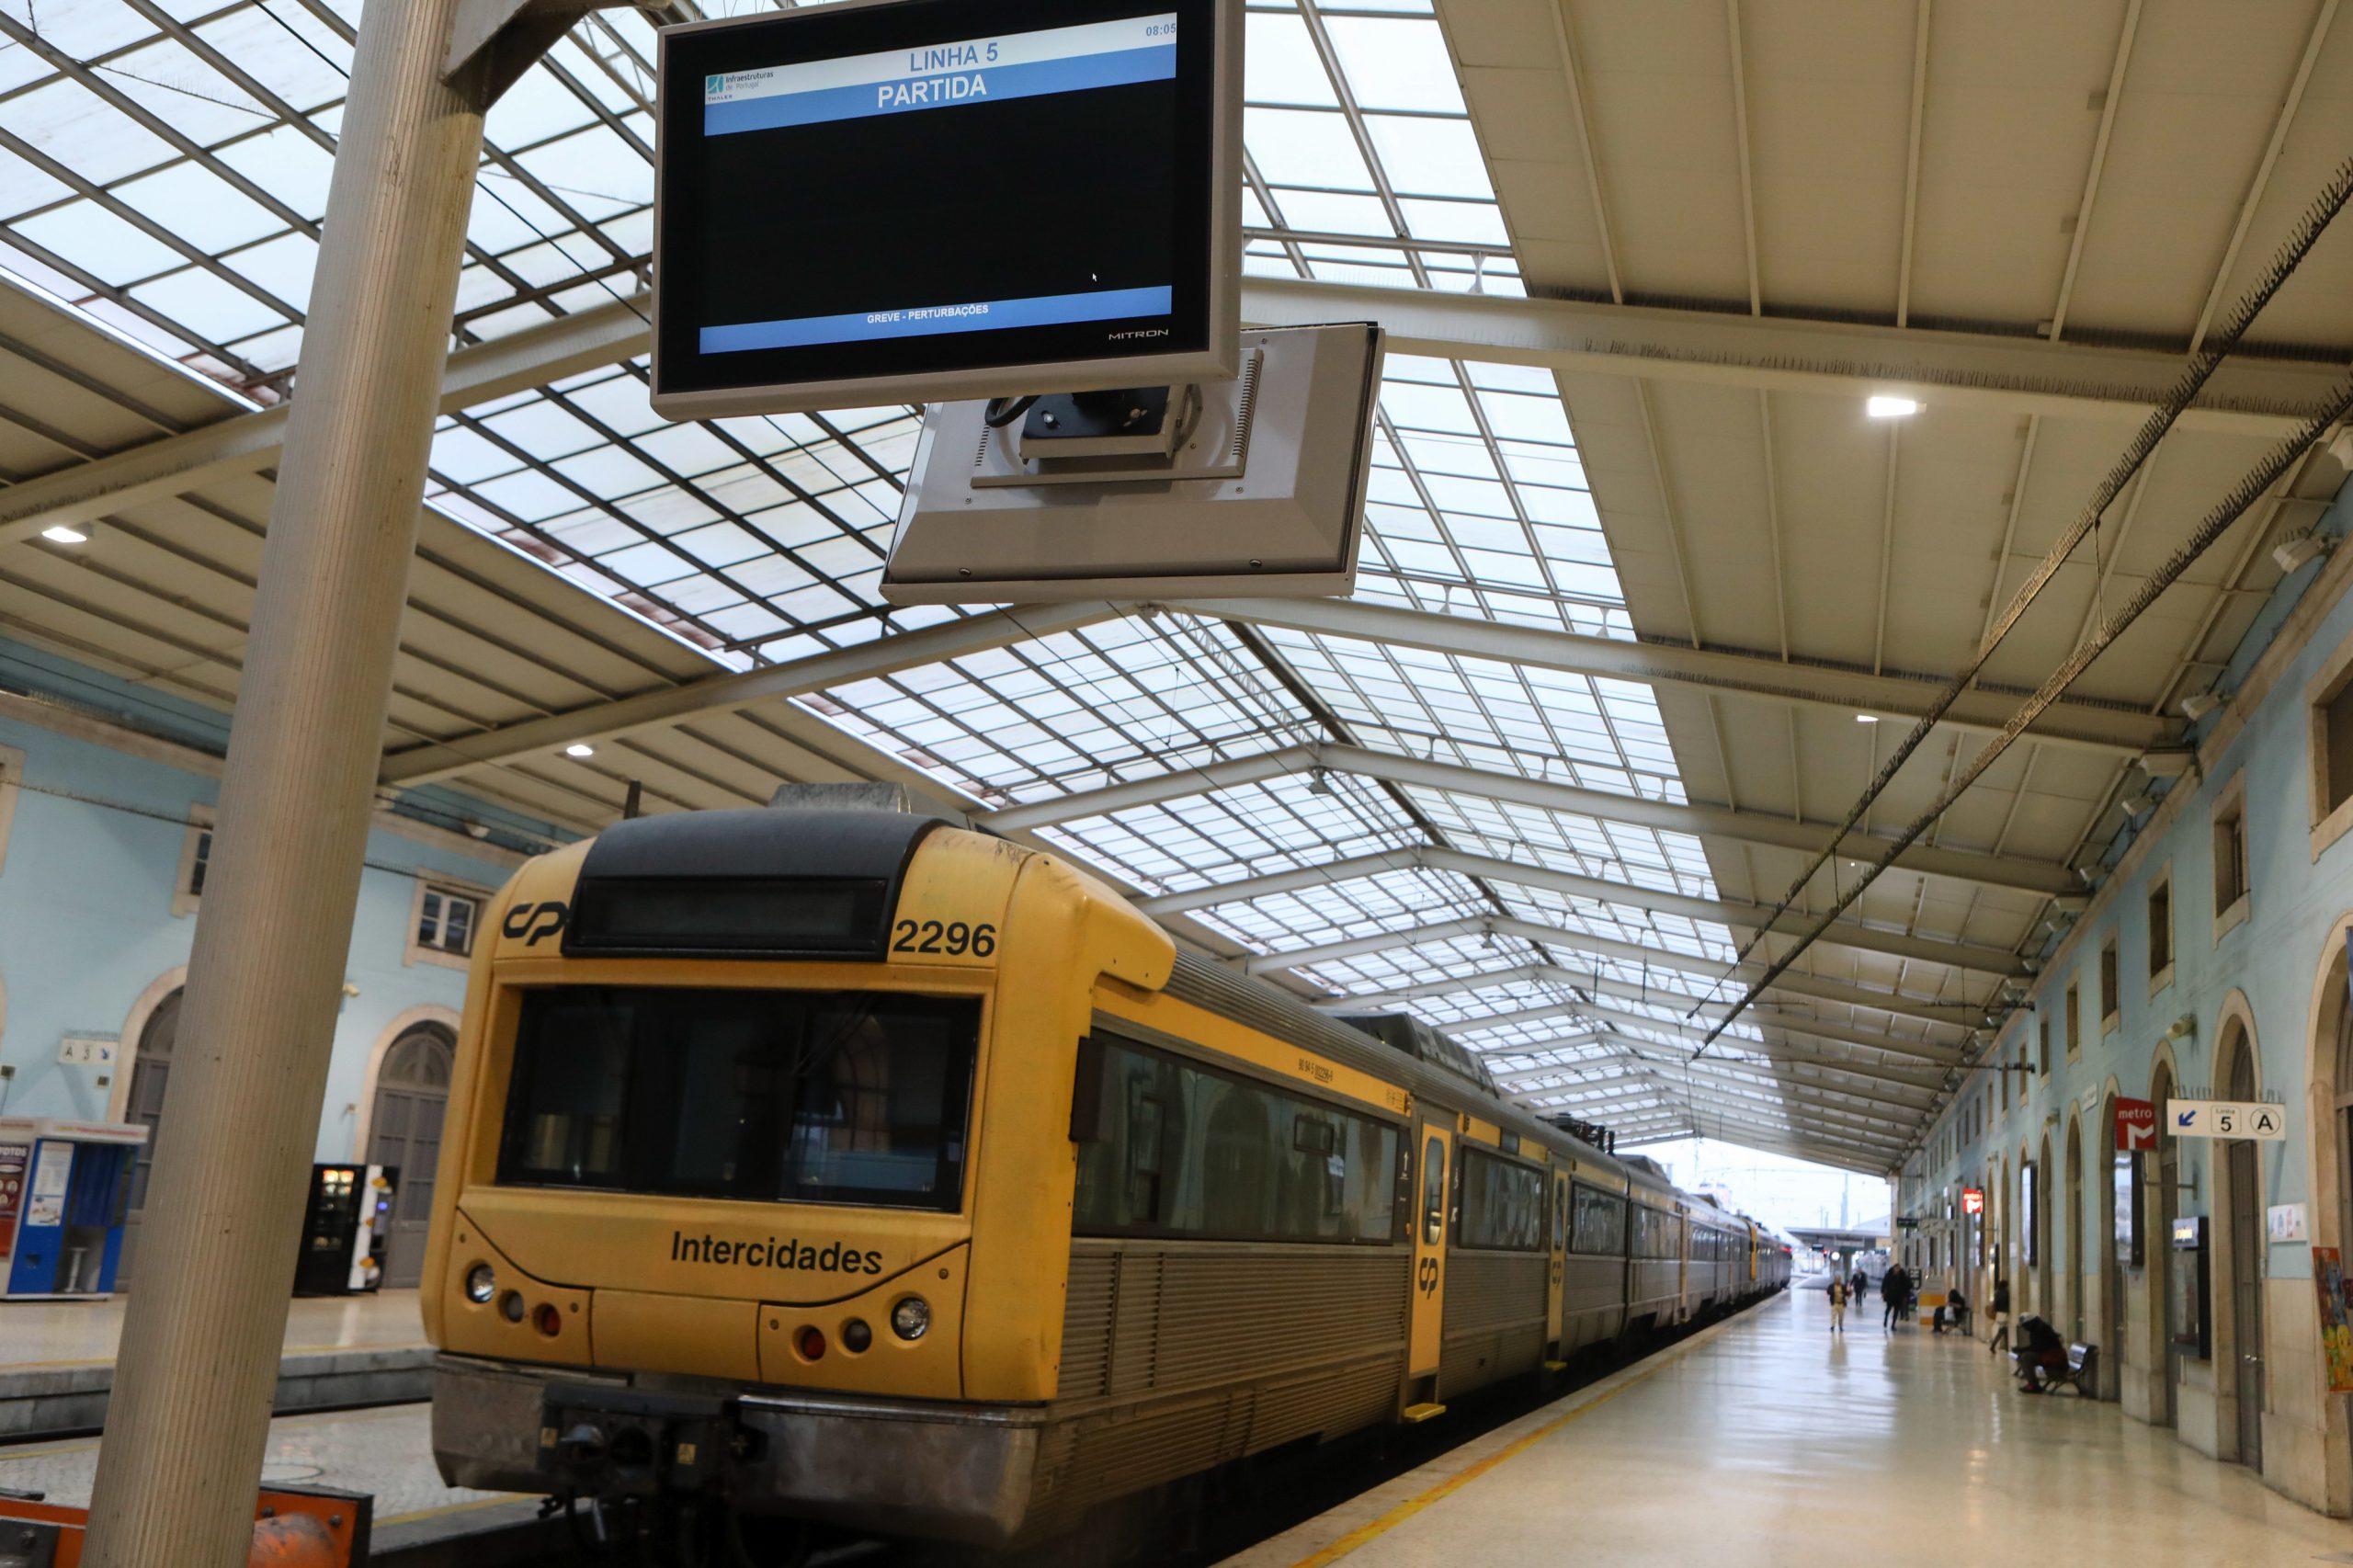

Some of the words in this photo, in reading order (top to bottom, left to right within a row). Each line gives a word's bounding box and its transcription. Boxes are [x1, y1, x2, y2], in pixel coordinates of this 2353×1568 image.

[1145, 22, 1176, 37] 08:05
[910, 44, 979, 73] LINHA
[986, 42, 999, 62] 5
[725, 72, 774, 84] Infraestruturas
[735, 80, 759, 90] Portugal
[877, 74, 988, 108] PARTIDA
[867, 312, 900, 324] GREVE
[908, 304, 989, 321] PERTURBAÇÕES
[1108, 328, 1169, 341] MITRON
[892, 919, 996, 958] 2296
[2118, 1108, 2153, 1119] metro
[2215, 1107, 2236, 1115] Linha
[2220, 1116, 2233, 1132] 5
[2257, 1114, 2274, 1131] A
[671, 1231, 883, 1276] Intercidades
